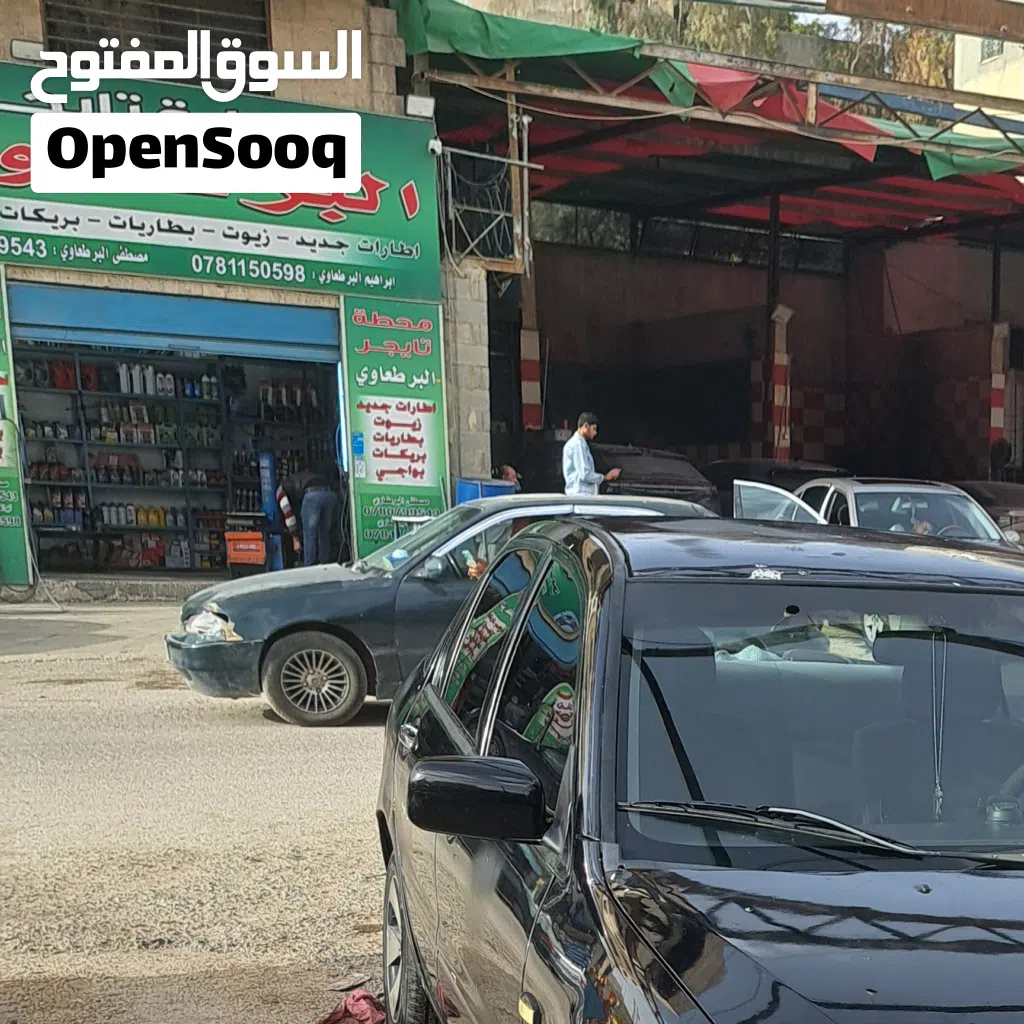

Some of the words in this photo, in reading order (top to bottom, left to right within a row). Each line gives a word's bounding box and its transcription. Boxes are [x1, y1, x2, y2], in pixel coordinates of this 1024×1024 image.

[0, 205, 80, 231] بريكات
[108, 214, 195, 241] بطاريات
[221, 224, 270, 247] زيوت
[296, 234, 349, 255] جديد
[357, 238, 421, 261] اطارات
[191, 253, 306, 283] 0781150598
[352, 308, 433, 332] محطة
[354, 337, 432, 358] تايجر
[356, 400, 392, 414] جديد
[373, 416, 422, 431] زيوت
[373, 432, 424, 448] بطاريات
[372, 448, 427, 464] بريكات
